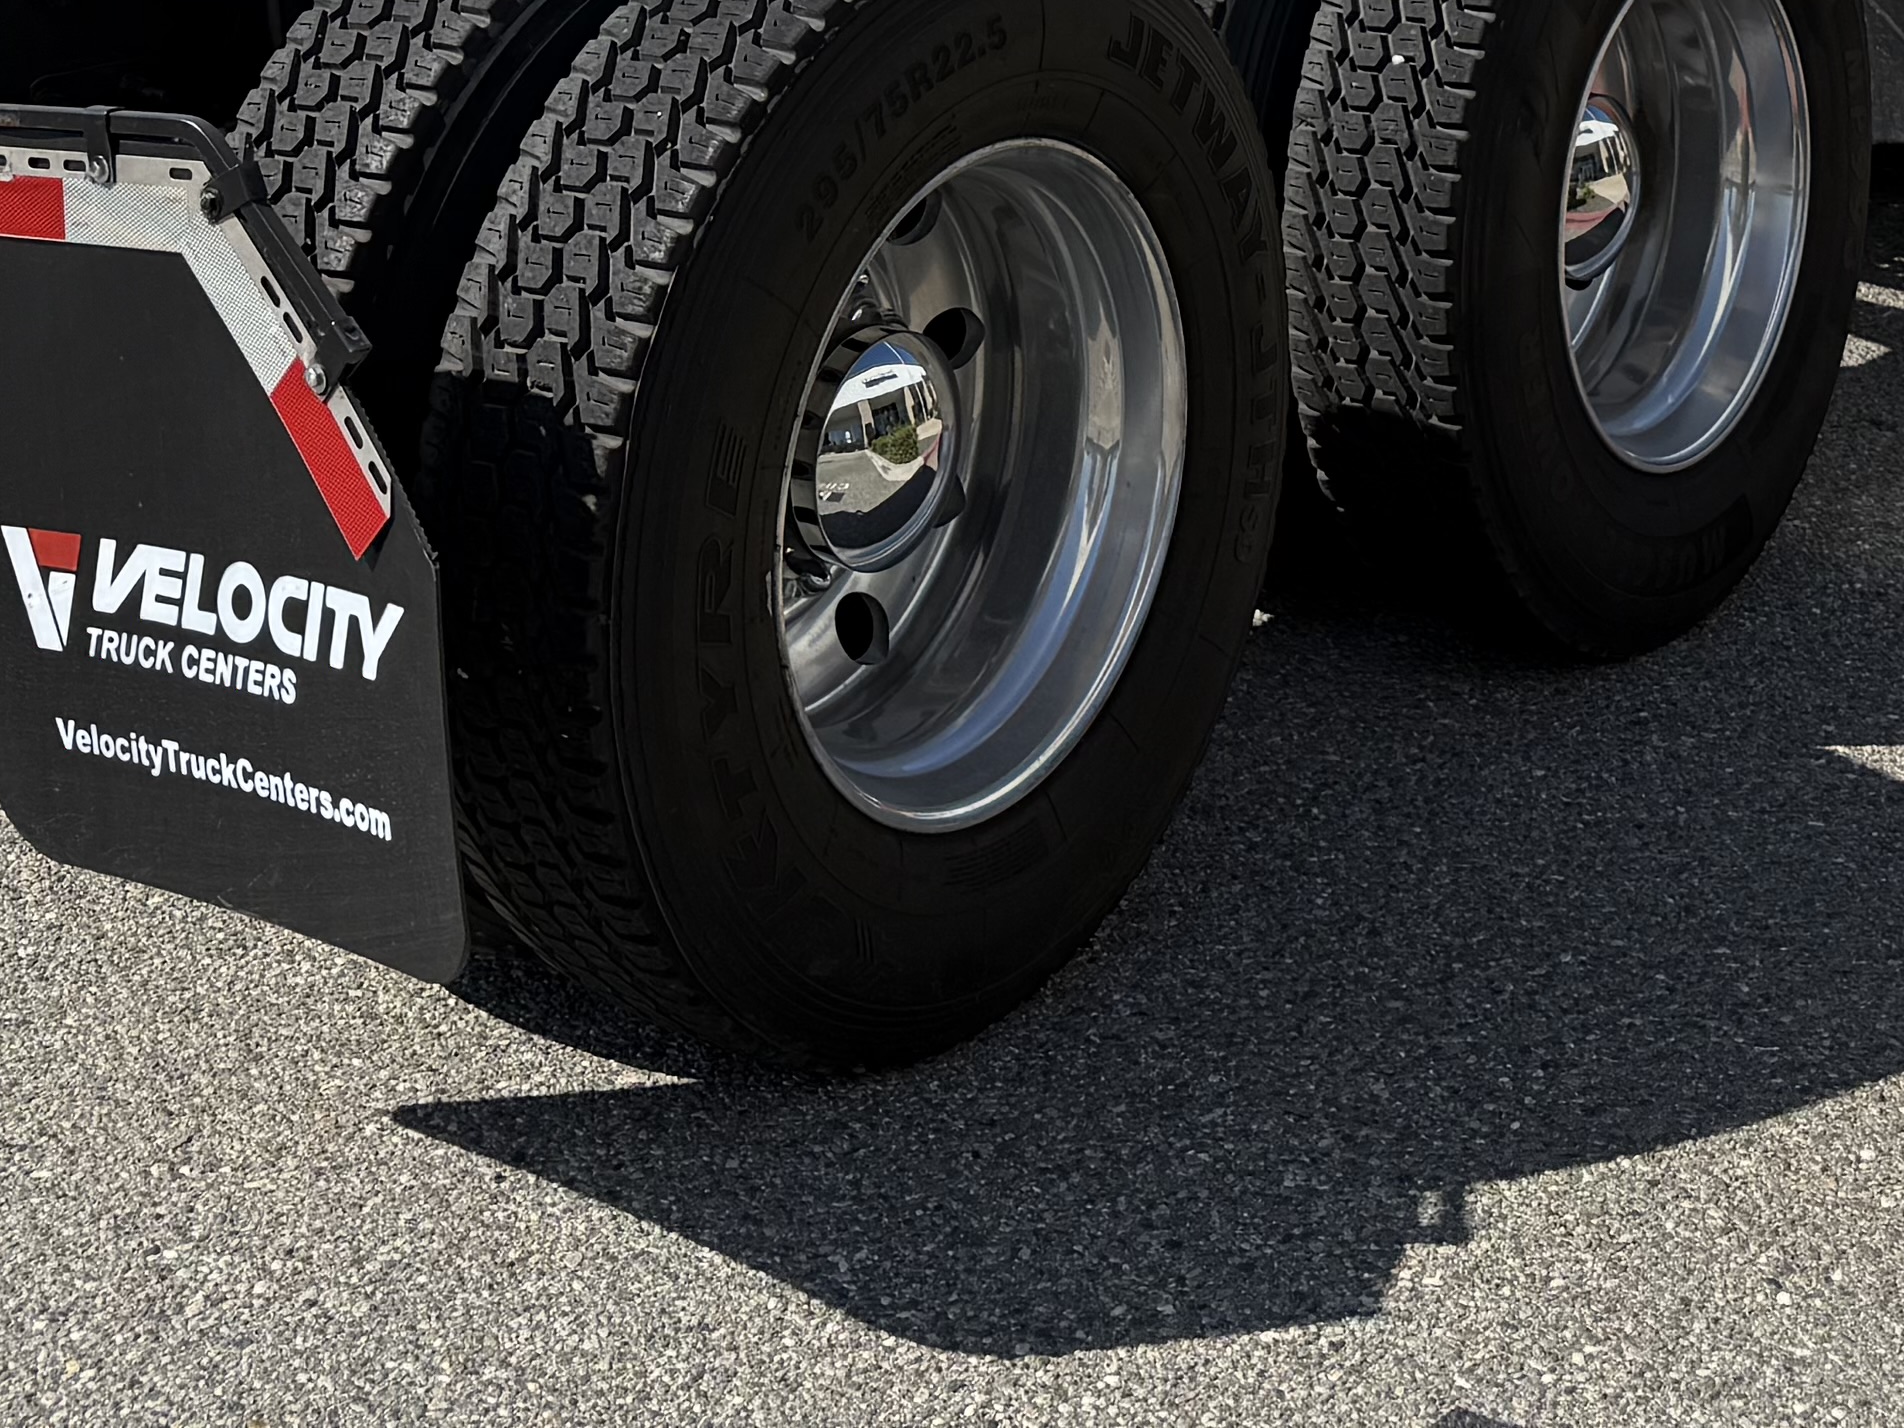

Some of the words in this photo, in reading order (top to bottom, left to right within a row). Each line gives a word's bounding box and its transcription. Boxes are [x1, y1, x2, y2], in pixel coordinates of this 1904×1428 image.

[793, 11, 1010, 245] 295/75R22.5
[86, 626, 174, 674] TRUCK
[180, 644, 297, 705] CENTERS
[91, 537, 405, 681] VELOCITY
[55, 716, 393, 842] VelocityTruckCenters.com
